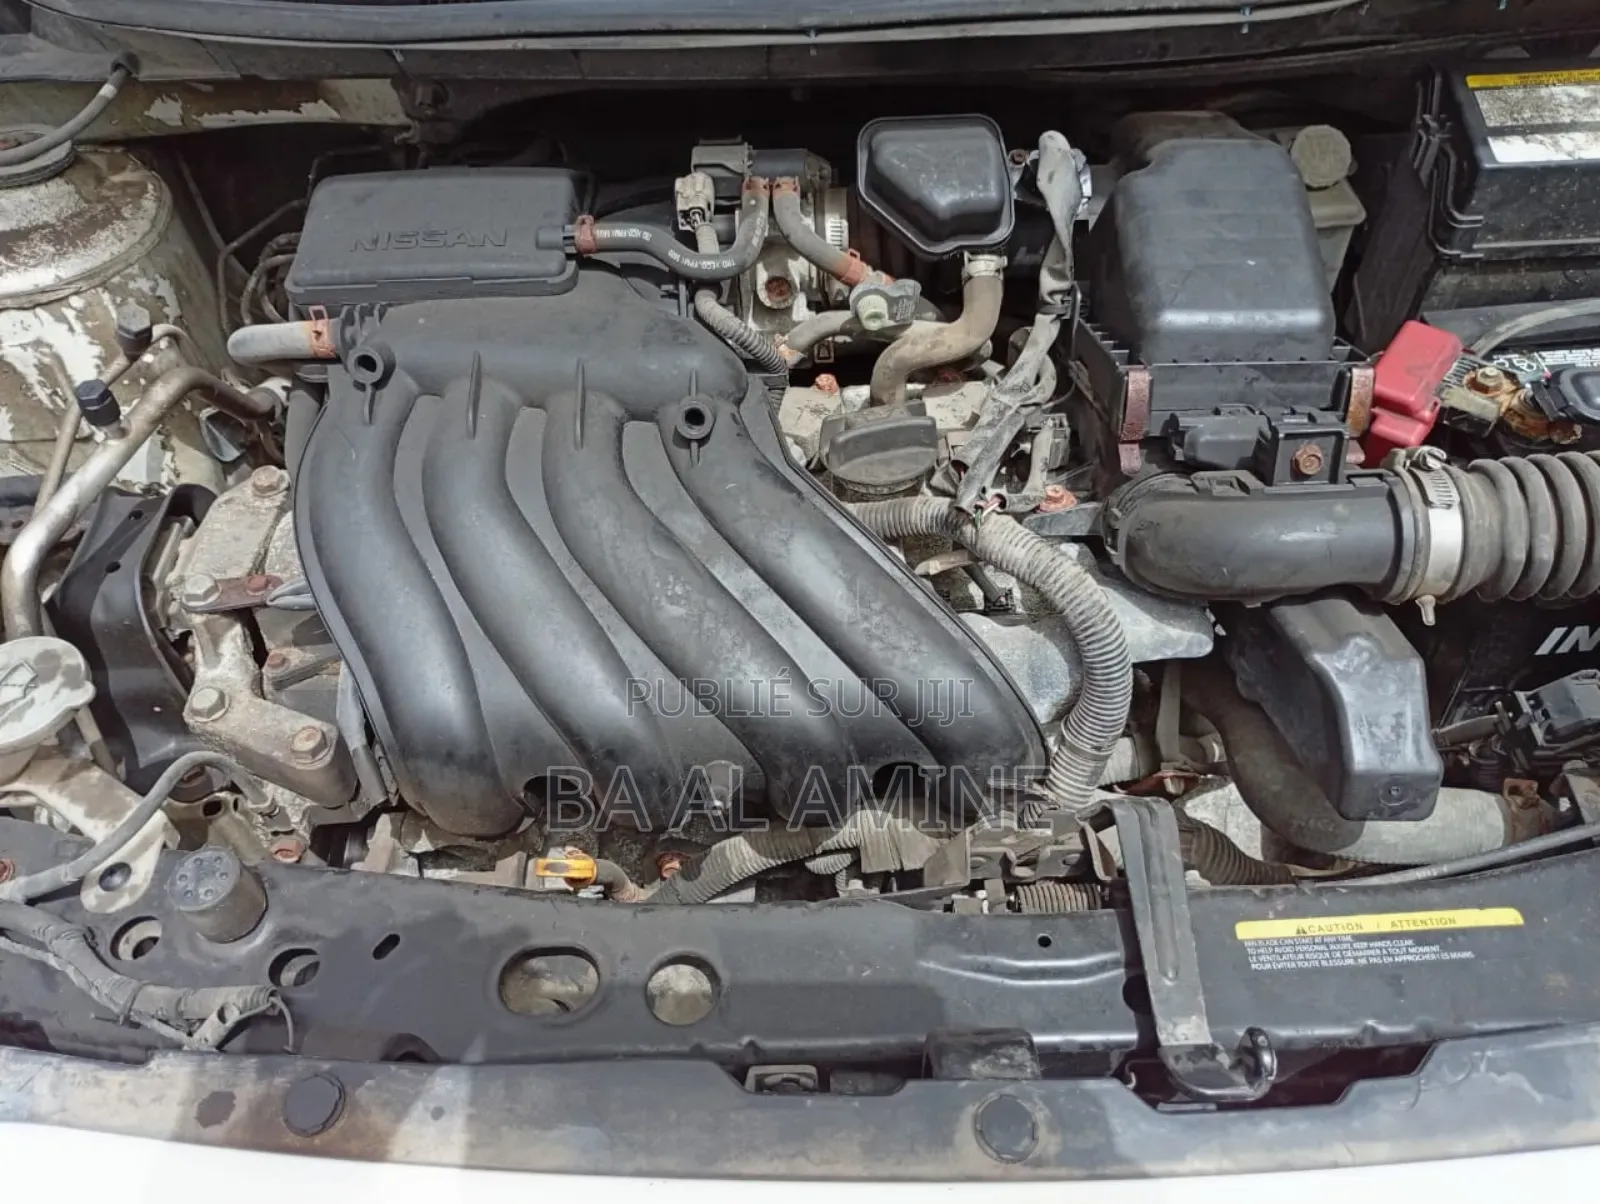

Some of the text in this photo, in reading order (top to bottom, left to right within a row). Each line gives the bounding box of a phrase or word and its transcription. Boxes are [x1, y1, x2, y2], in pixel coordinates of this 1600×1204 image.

[350, 229, 508, 252] NISSAN
[1308, 923, 1363, 933] CAUTION
[1390, 917, 1456, 929] ATTENTION
[1246, 947, 1256, 955] TO
[1257, 946, 1273, 954] HELP
[1274, 945, 1294, 954] AVOID
[1295, 944, 1328, 953] PERSONAL
[1353, 941, 1368, 949] KEEP
[1369, 940, 1391, 948] HANDS
[1279, 938, 1294, 946] CAN
[1294, 937, 1313, 945] START
[1250, 962, 1272, 971] POUR
[1297, 960, 1320, 969] TOUTE
[1357, 957, 1368, 965] NE
[1369, 956, 1382, 965] PAS
[1394, 953, 1438, 962] APPROCHER
[1258, 953, 1304, 962] VENTILATEUR
[1305, 951, 1330, 961] RISQUE
[1331, 951, 1341, 959] DE
[1388, 946, 1407, 955] TOUT
